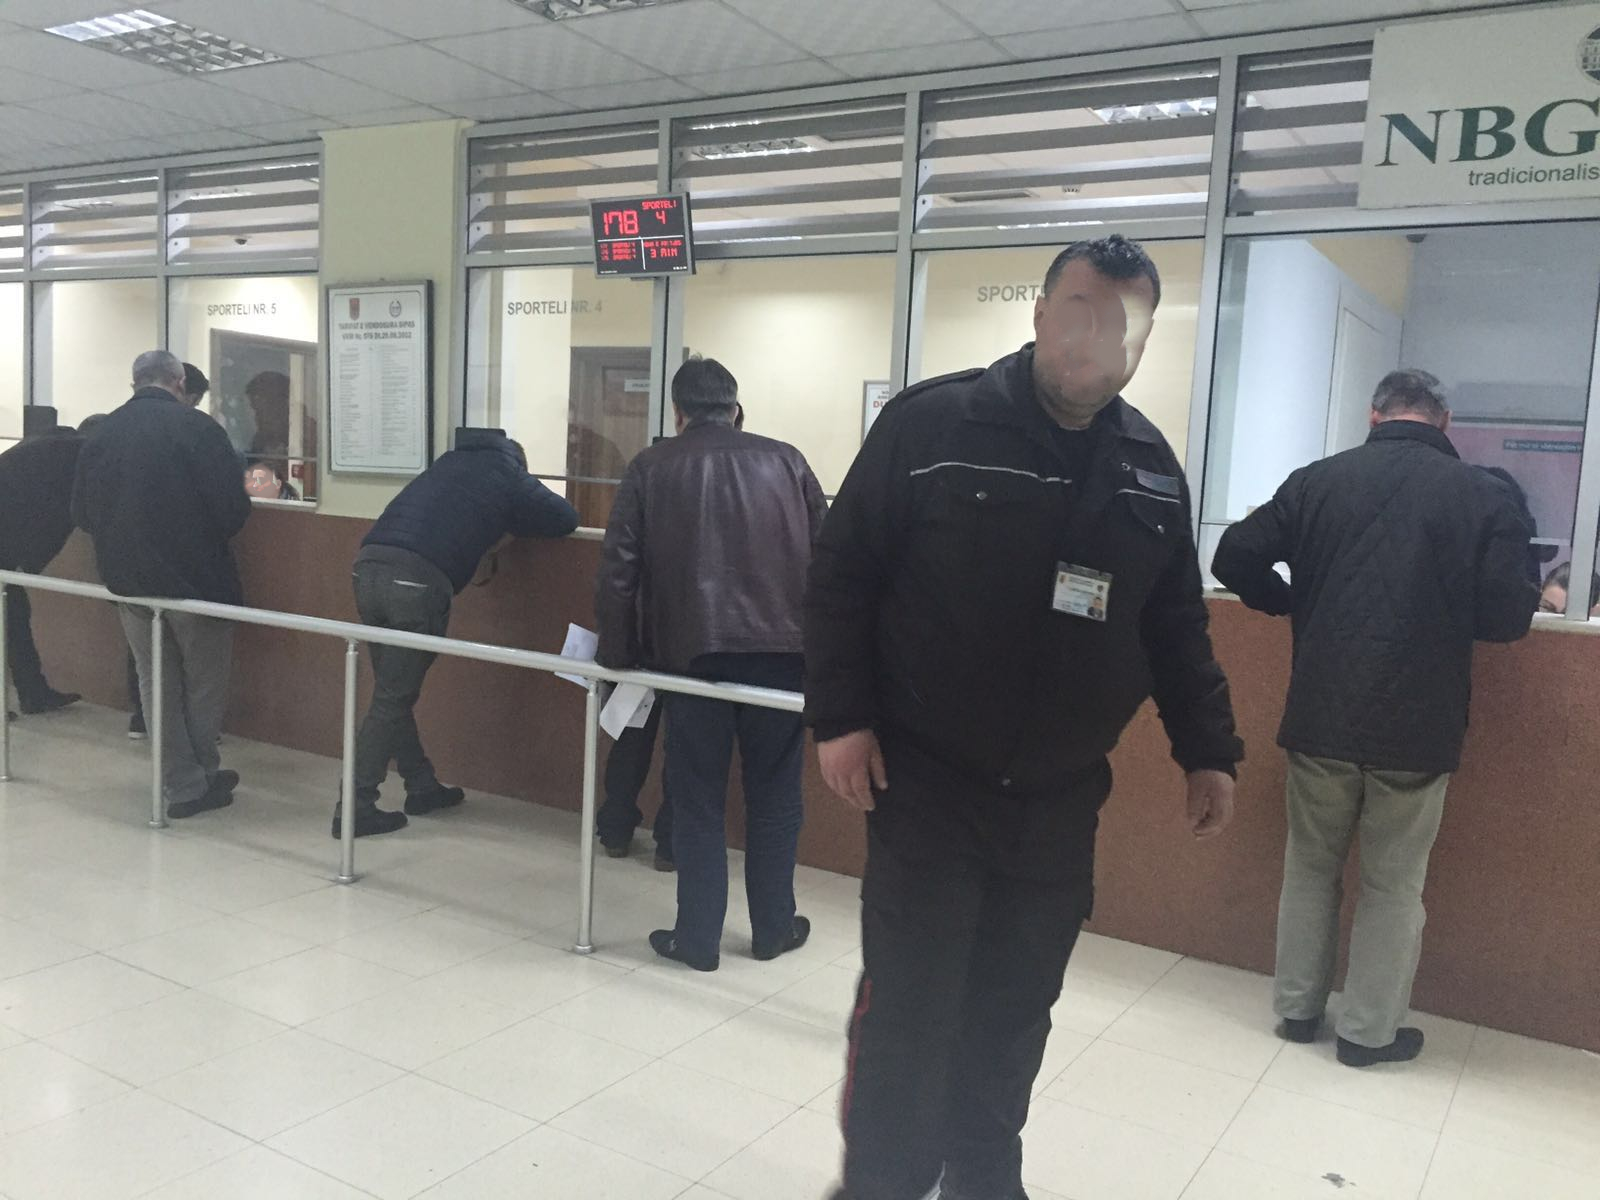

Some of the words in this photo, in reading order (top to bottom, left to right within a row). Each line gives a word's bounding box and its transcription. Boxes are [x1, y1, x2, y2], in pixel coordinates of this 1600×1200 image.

[1374, 98, 1600, 167] NBG
[642, 199, 676, 210] SPORTELI
[603, 210, 639, 235] 178
[655, 211, 666, 225] 4
[207, 303, 251, 316] SPORTELI
[271, 302, 277, 314] 5
[507, 301, 567, 315] SPORTELI
